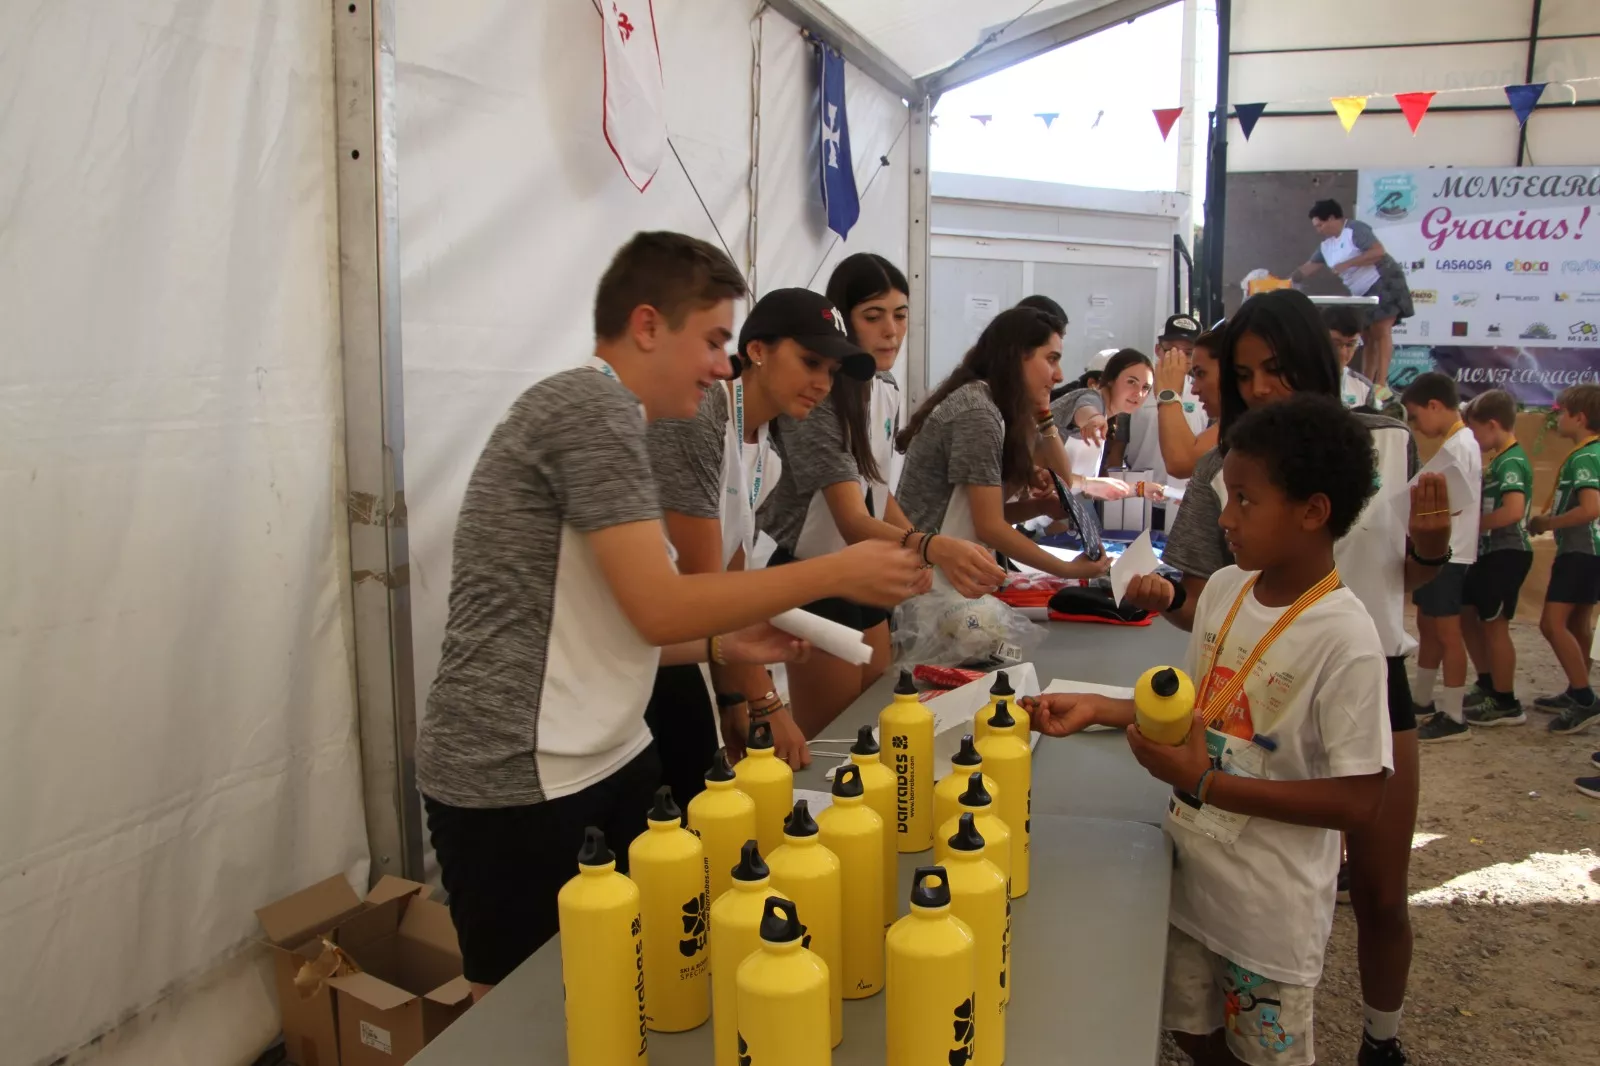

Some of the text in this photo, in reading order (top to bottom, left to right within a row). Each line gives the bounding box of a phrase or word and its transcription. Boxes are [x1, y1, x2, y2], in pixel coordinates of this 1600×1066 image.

[1420, 206, 1592, 251] Gracias!
[1505, 258, 1549, 272] eboca
[634, 939, 648, 1057] barrabes
